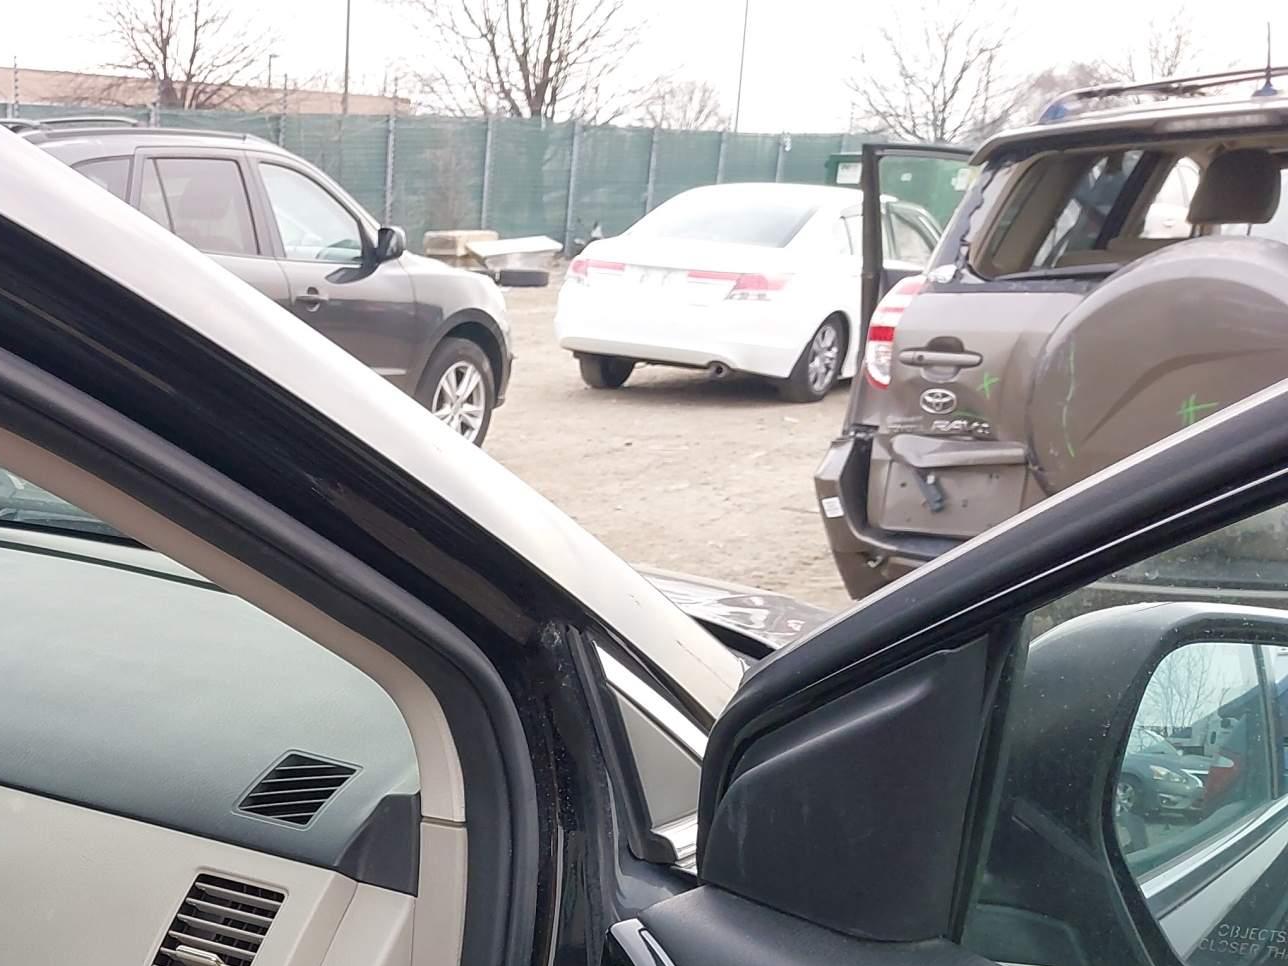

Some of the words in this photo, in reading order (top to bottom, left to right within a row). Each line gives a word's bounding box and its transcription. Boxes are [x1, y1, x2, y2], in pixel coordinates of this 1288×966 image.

[1218, 923, 1287, 943] OBJECTS
[1198, 937, 1261, 957] CLOSER
[1266, 945, 1288, 960] TH
